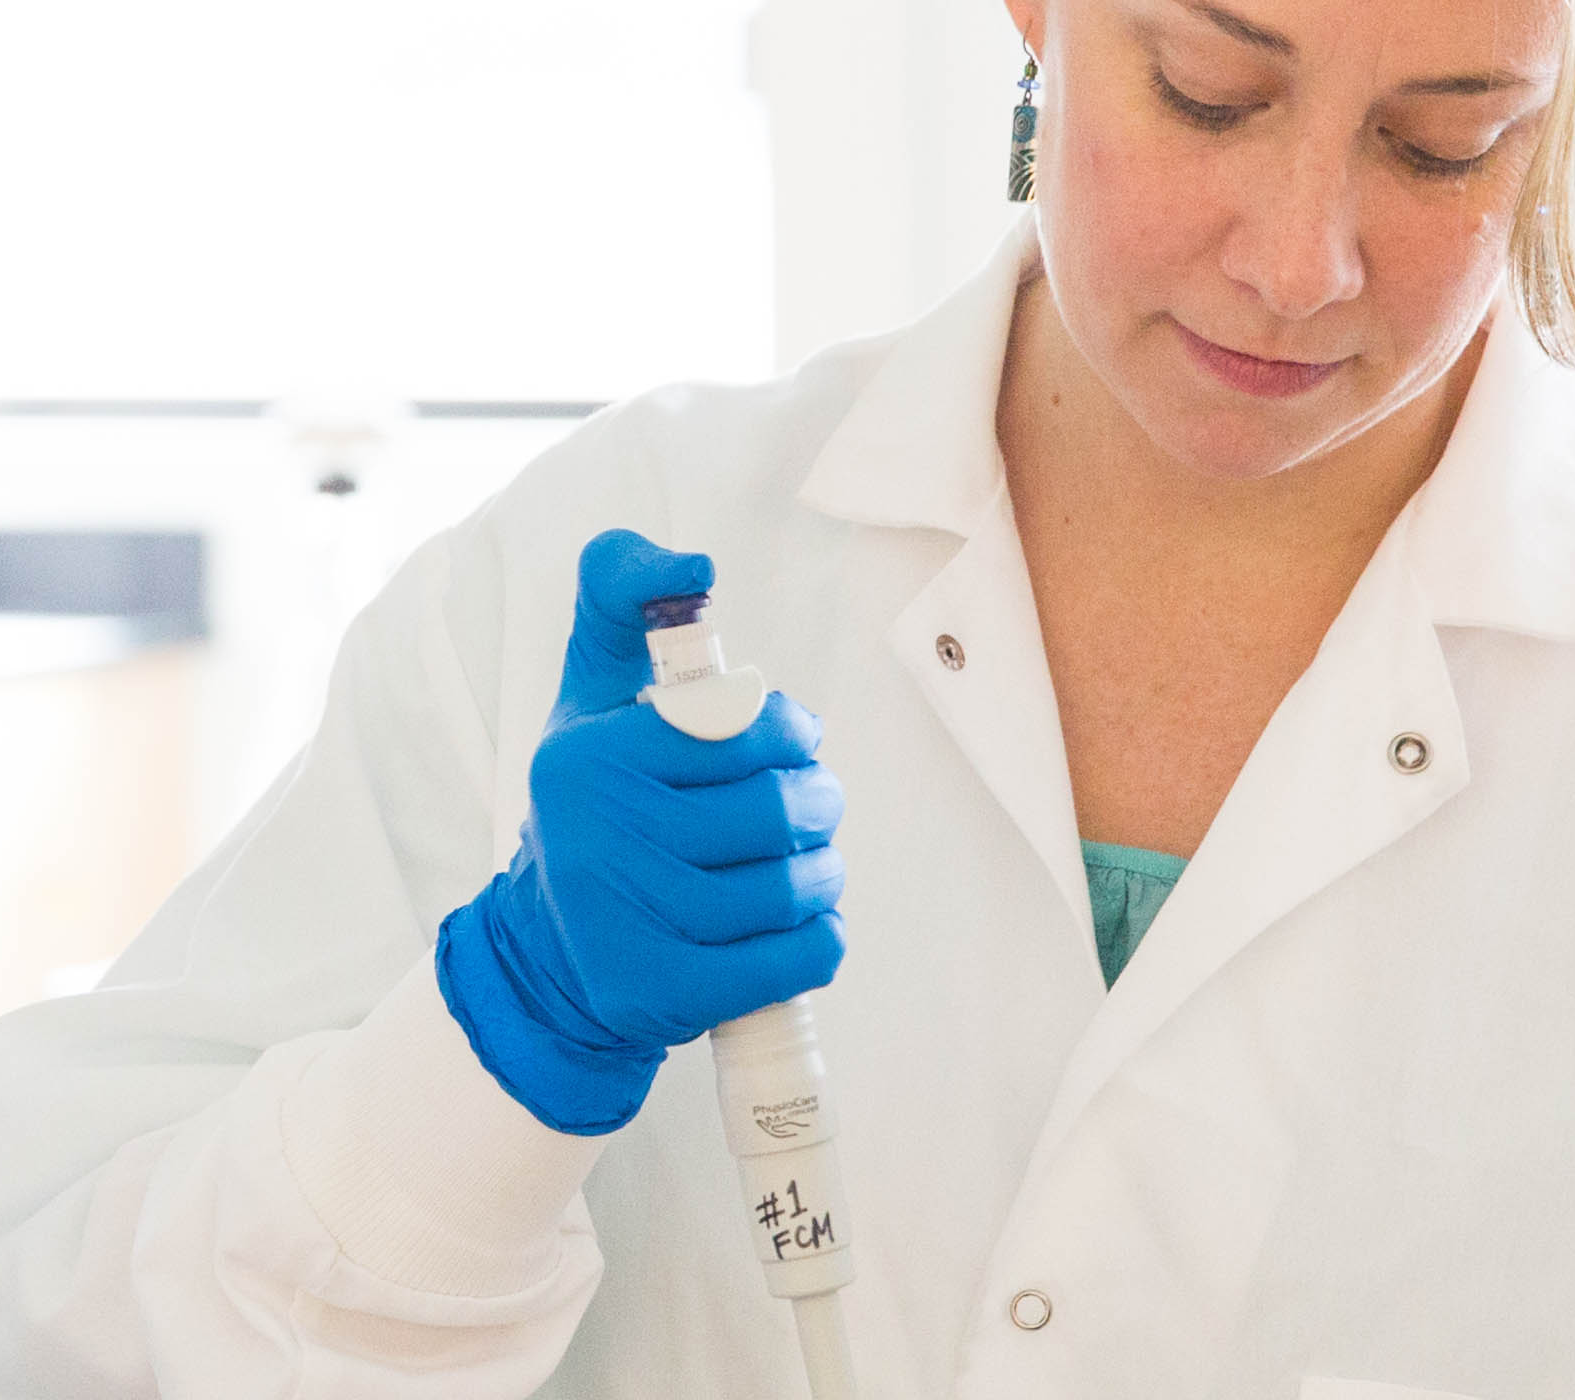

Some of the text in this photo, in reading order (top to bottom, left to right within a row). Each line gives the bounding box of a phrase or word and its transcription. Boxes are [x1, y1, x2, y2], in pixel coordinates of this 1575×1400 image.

[753, 1095, 818, 1115] PhysioCare
[755, 1180, 808, 1230] #1
[772, 1211, 835, 1260] FCM
